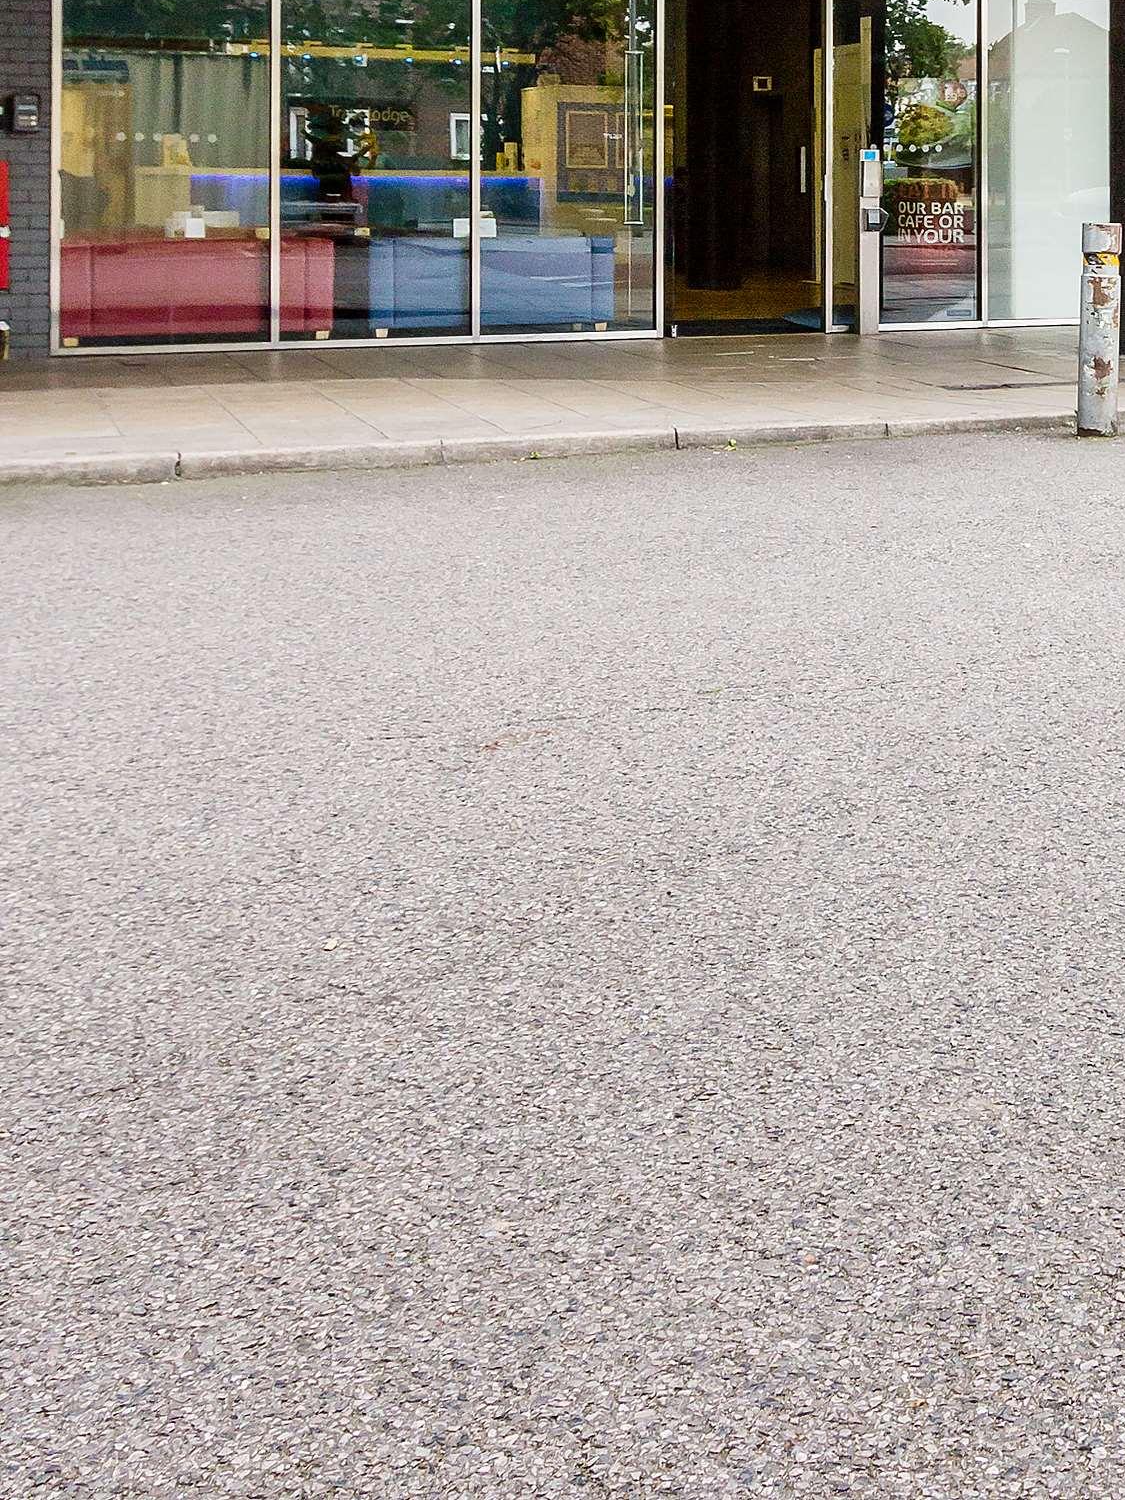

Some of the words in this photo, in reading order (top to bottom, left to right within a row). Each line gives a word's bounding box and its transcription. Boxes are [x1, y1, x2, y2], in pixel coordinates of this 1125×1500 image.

[898, 201, 927, 215] OUR
[931, 201, 965, 215] BAR
[898, 214, 935, 228] CAFE
[938, 214, 965, 228] OR
[897, 228, 911, 243] IN
[914, 228, 965, 244] YOUR
